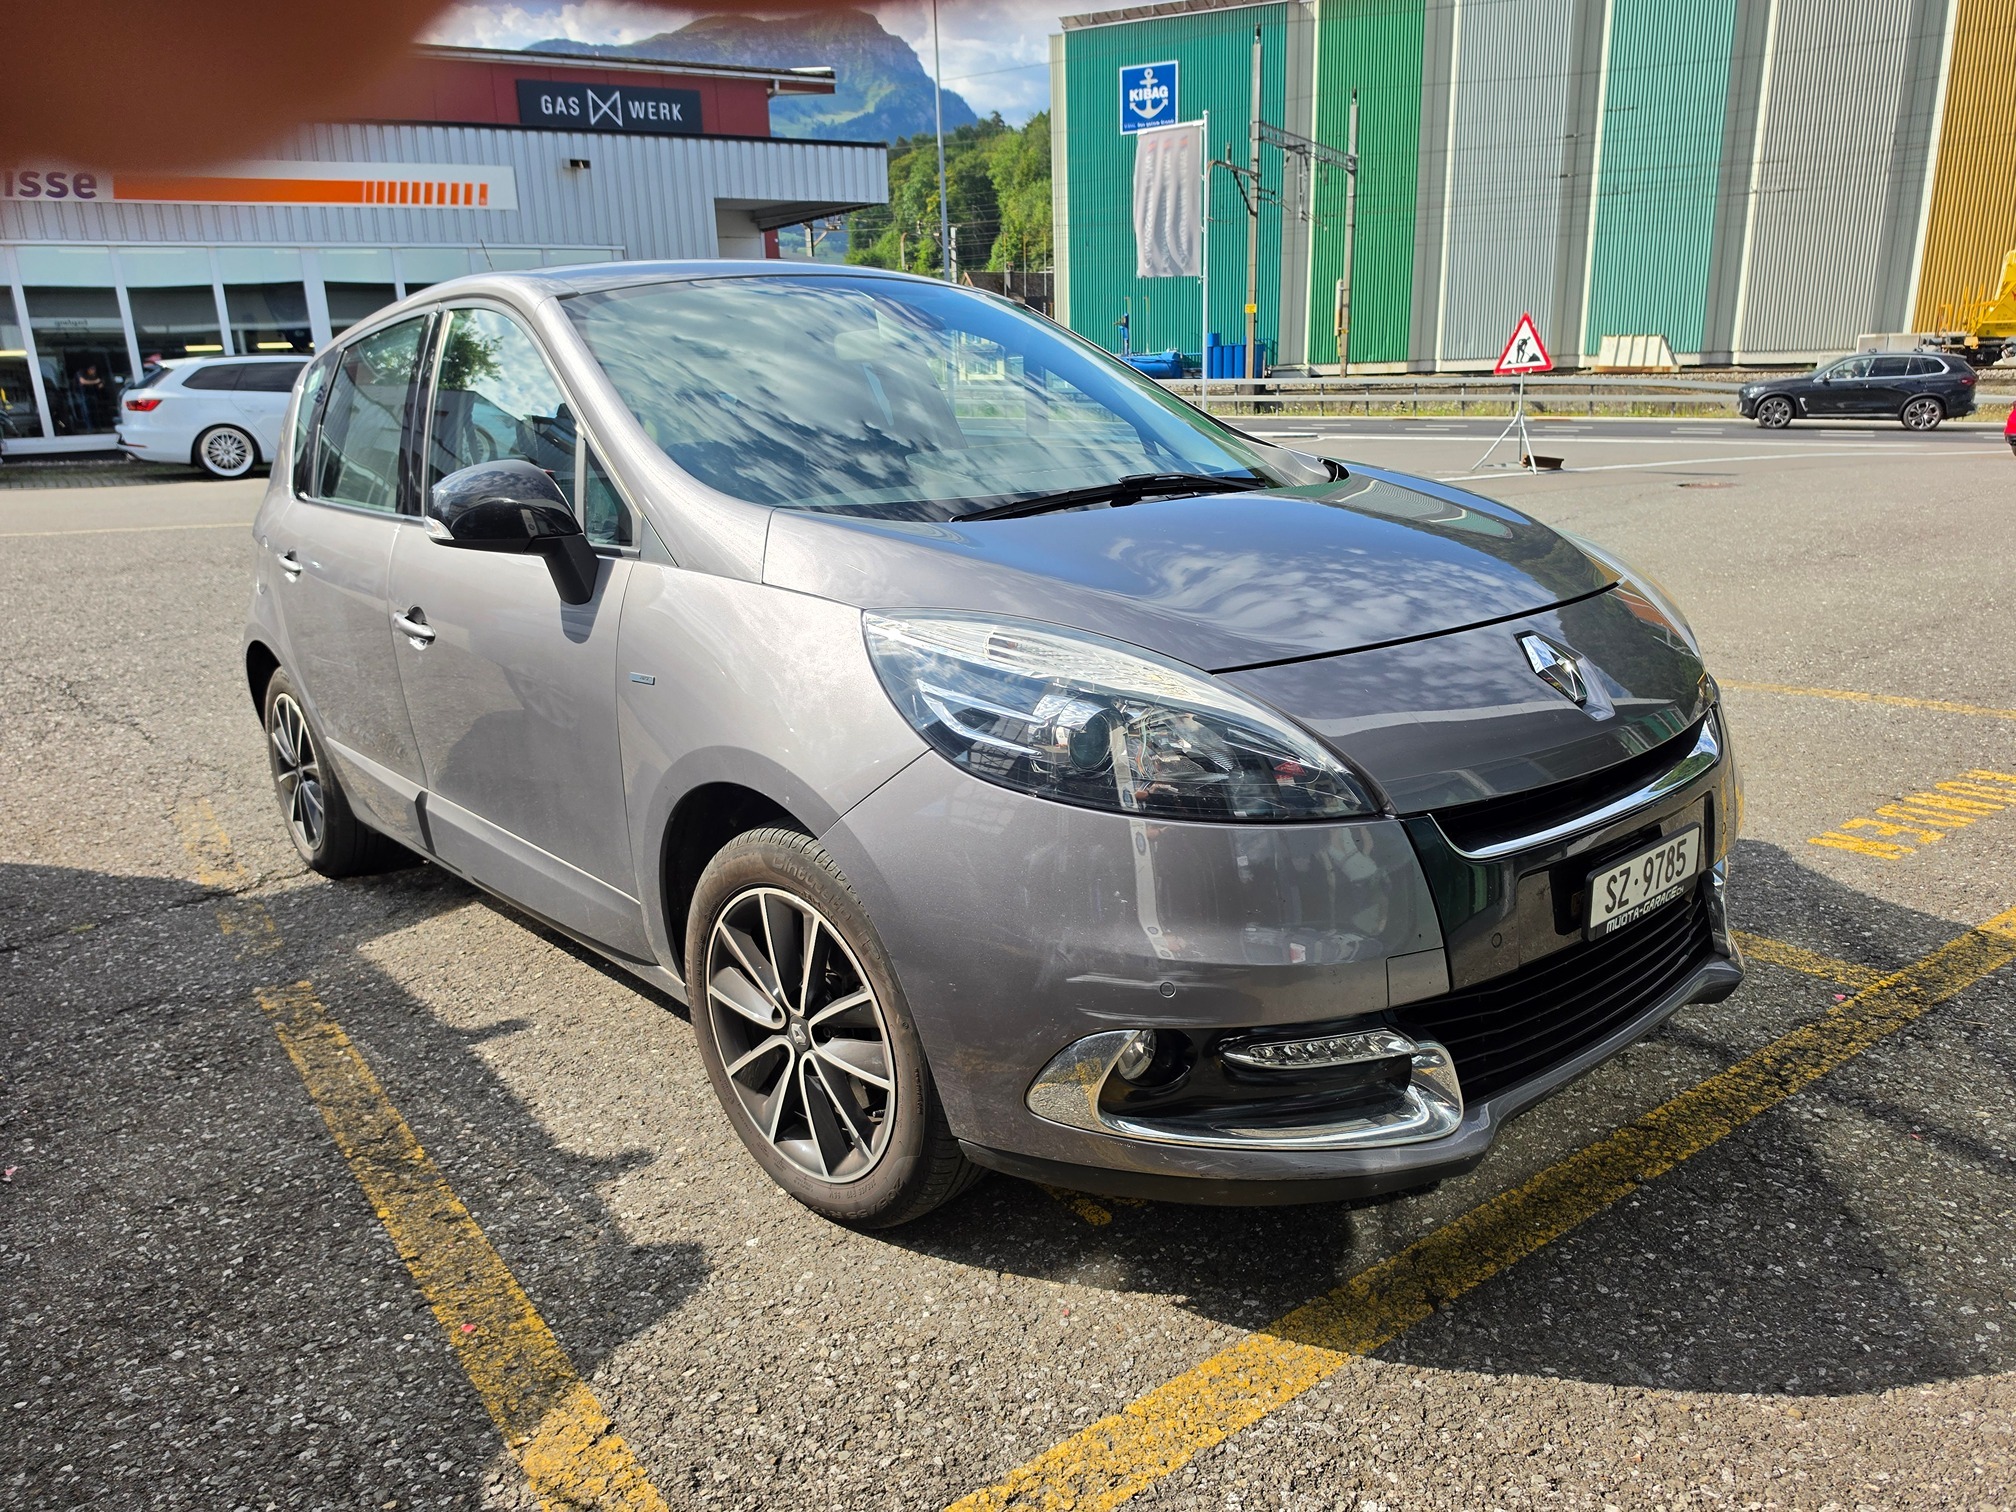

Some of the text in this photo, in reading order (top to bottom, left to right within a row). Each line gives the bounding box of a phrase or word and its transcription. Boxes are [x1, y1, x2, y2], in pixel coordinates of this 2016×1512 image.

[1129, 85, 1168, 102] KIBAG
[540, 94, 683, 122] GAS WERK
